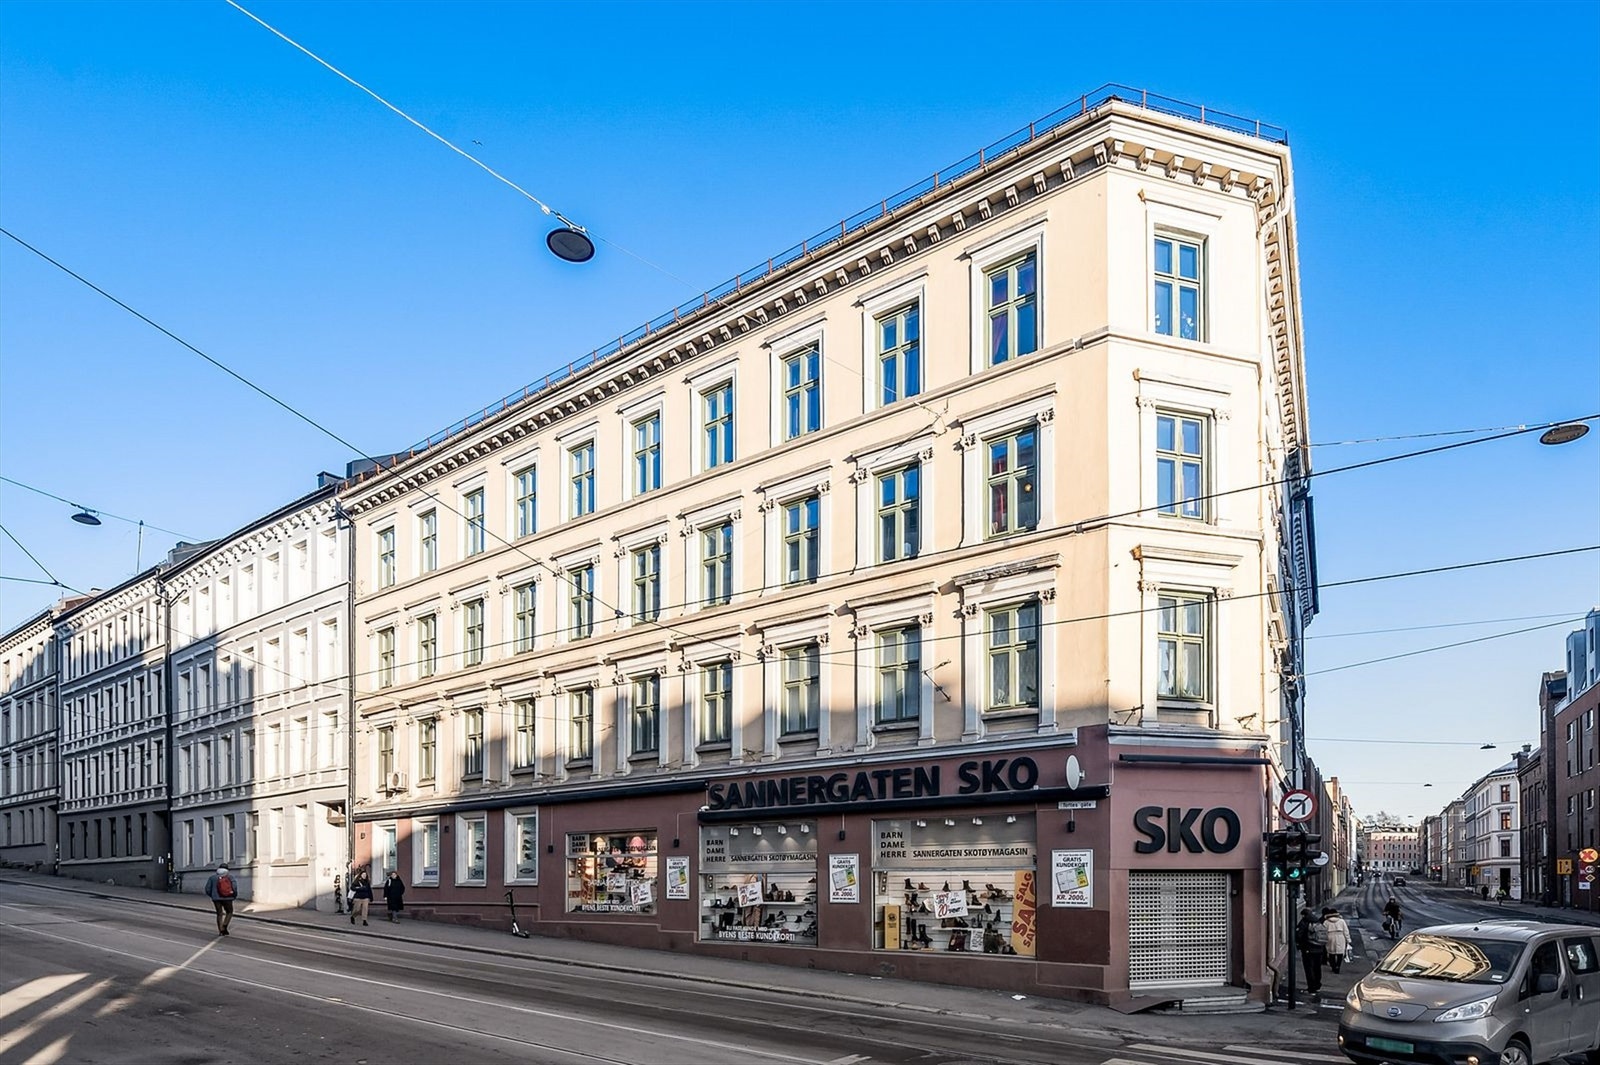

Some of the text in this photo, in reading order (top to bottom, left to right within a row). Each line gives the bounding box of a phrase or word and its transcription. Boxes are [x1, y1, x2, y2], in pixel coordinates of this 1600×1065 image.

[709, 756, 1039, 810] SANNERGATEN SKO
[1134, 806, 1241, 854] SKO
[913, 847, 1028, 858] SANNERGATEN SKOTØYMAGASIN
[1016, 872, 1032, 902] SALG
